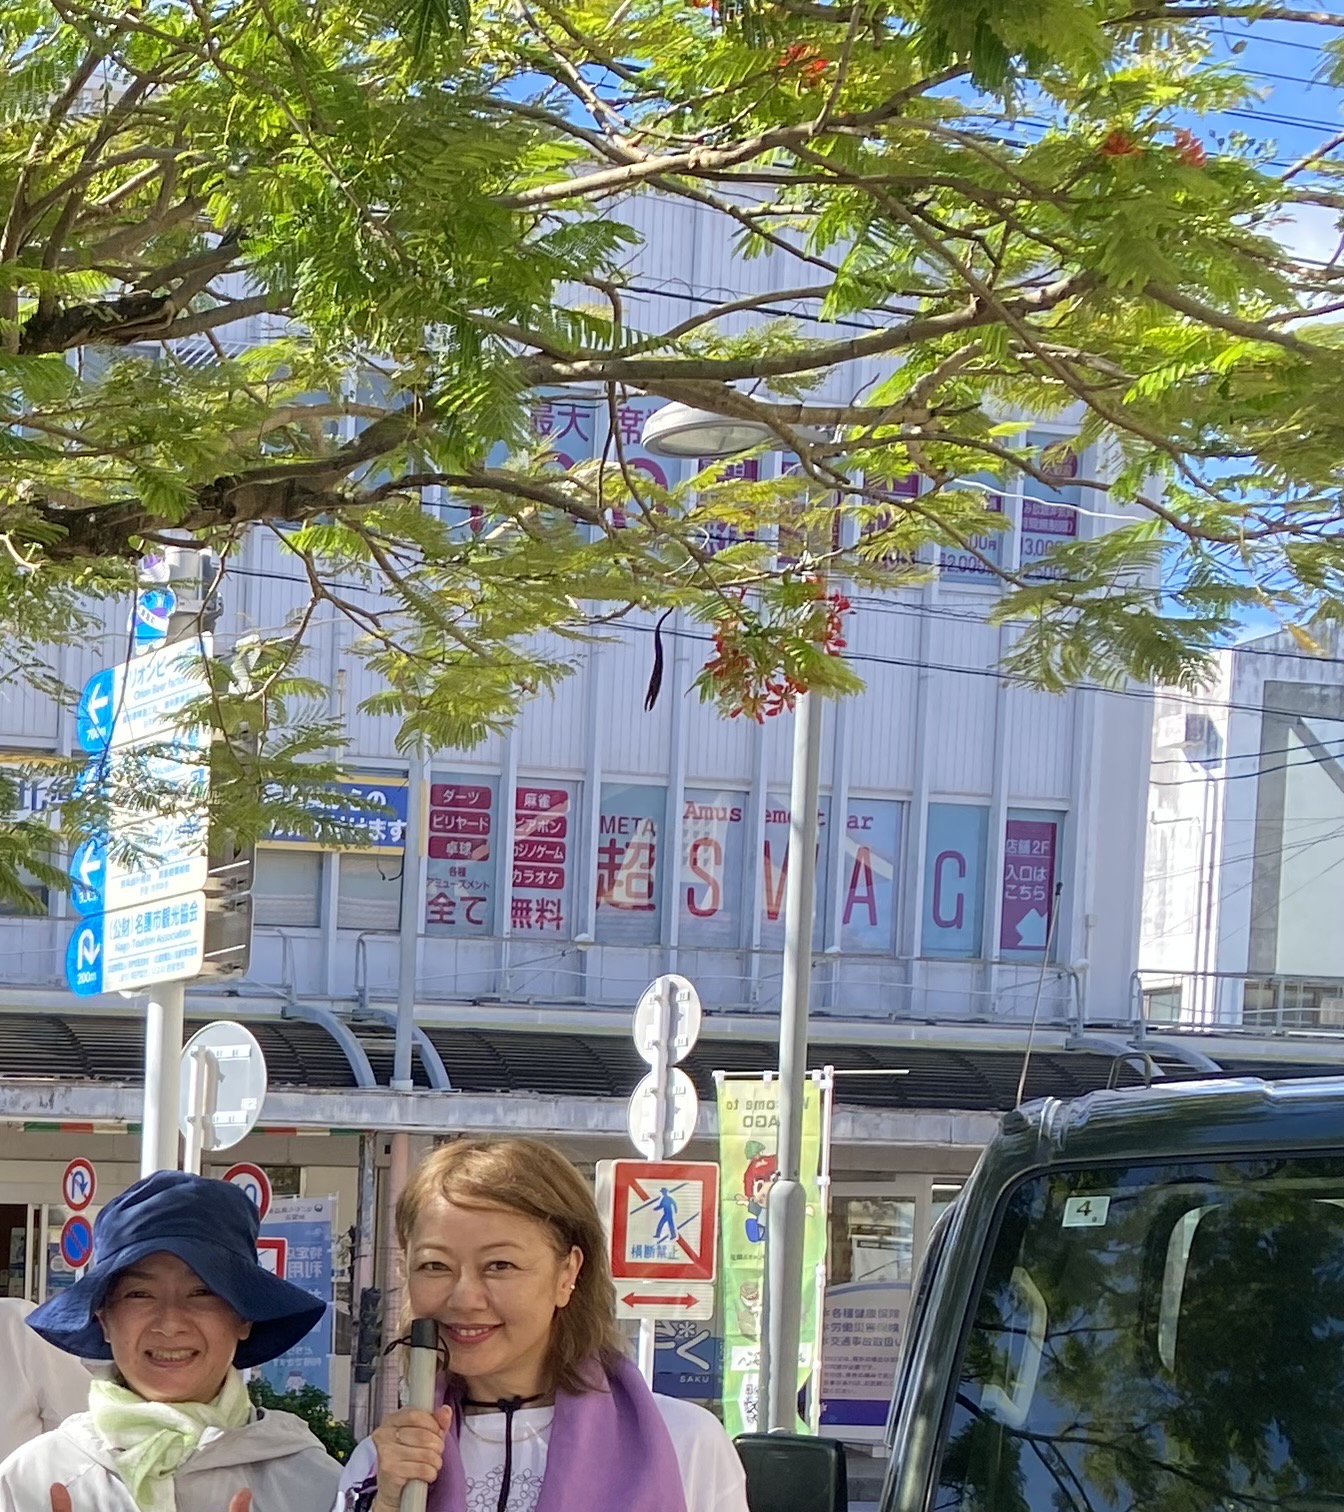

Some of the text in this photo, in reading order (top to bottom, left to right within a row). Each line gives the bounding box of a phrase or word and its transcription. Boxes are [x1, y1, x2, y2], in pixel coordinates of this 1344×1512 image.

[443, 788, 481, 804] ダーツ
[523, 792, 552, 809] 麻雀
[431, 815, 489, 832] ビリヤード
[600, 815, 656, 837] META
[445, 841, 473, 857] 卓球
[448, 866, 467, 878] 各種
[596, 837, 656, 913] 超
[1005, 863, 1048, 882] 入口は
[1005, 884, 1046, 901] こちら
[427, 891, 488, 926] 全て
[511, 897, 565, 931] 無料
[76, 970, 97, 985] 200m
[630, 1244, 679, 1260] 横断禁止
[679, 1375, 710, 1384] SAKU
